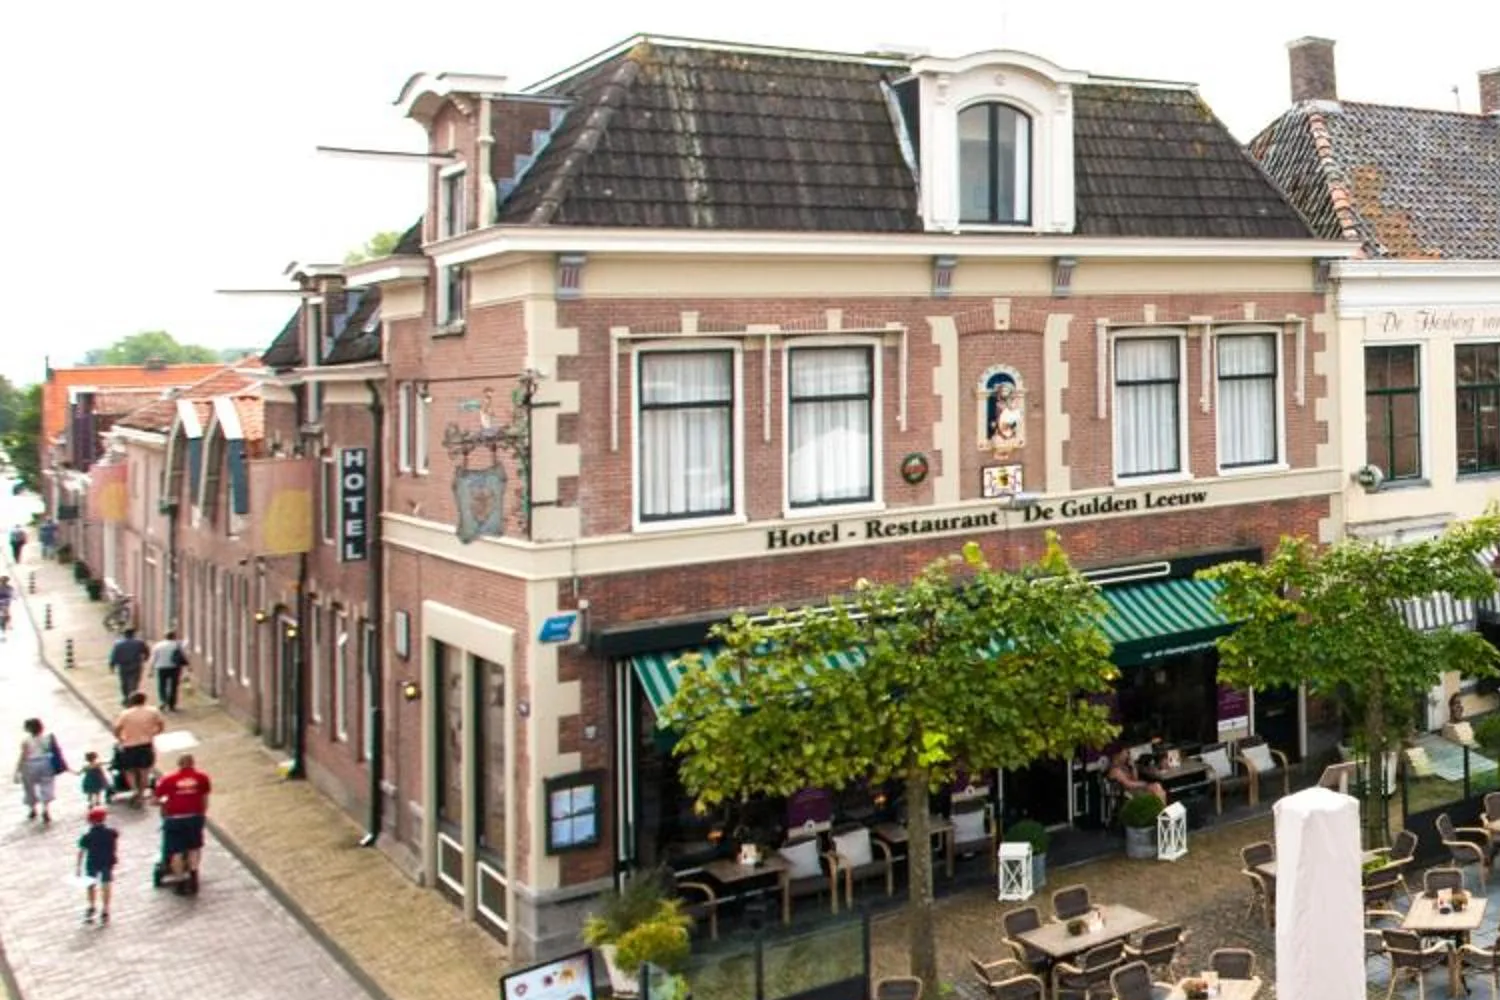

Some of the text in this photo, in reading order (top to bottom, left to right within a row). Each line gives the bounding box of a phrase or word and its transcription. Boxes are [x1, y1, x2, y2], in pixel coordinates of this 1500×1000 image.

[344, 450, 364, 560] HOTEL
[767, 523, 839, 549] Hotel
[865, 510, 999, 539] Restaurant
[1023, 503, 1055, 522] De
[1060, 497, 1138, 517] Gulden
[1144, 491, 1208, 509] Leeuw
